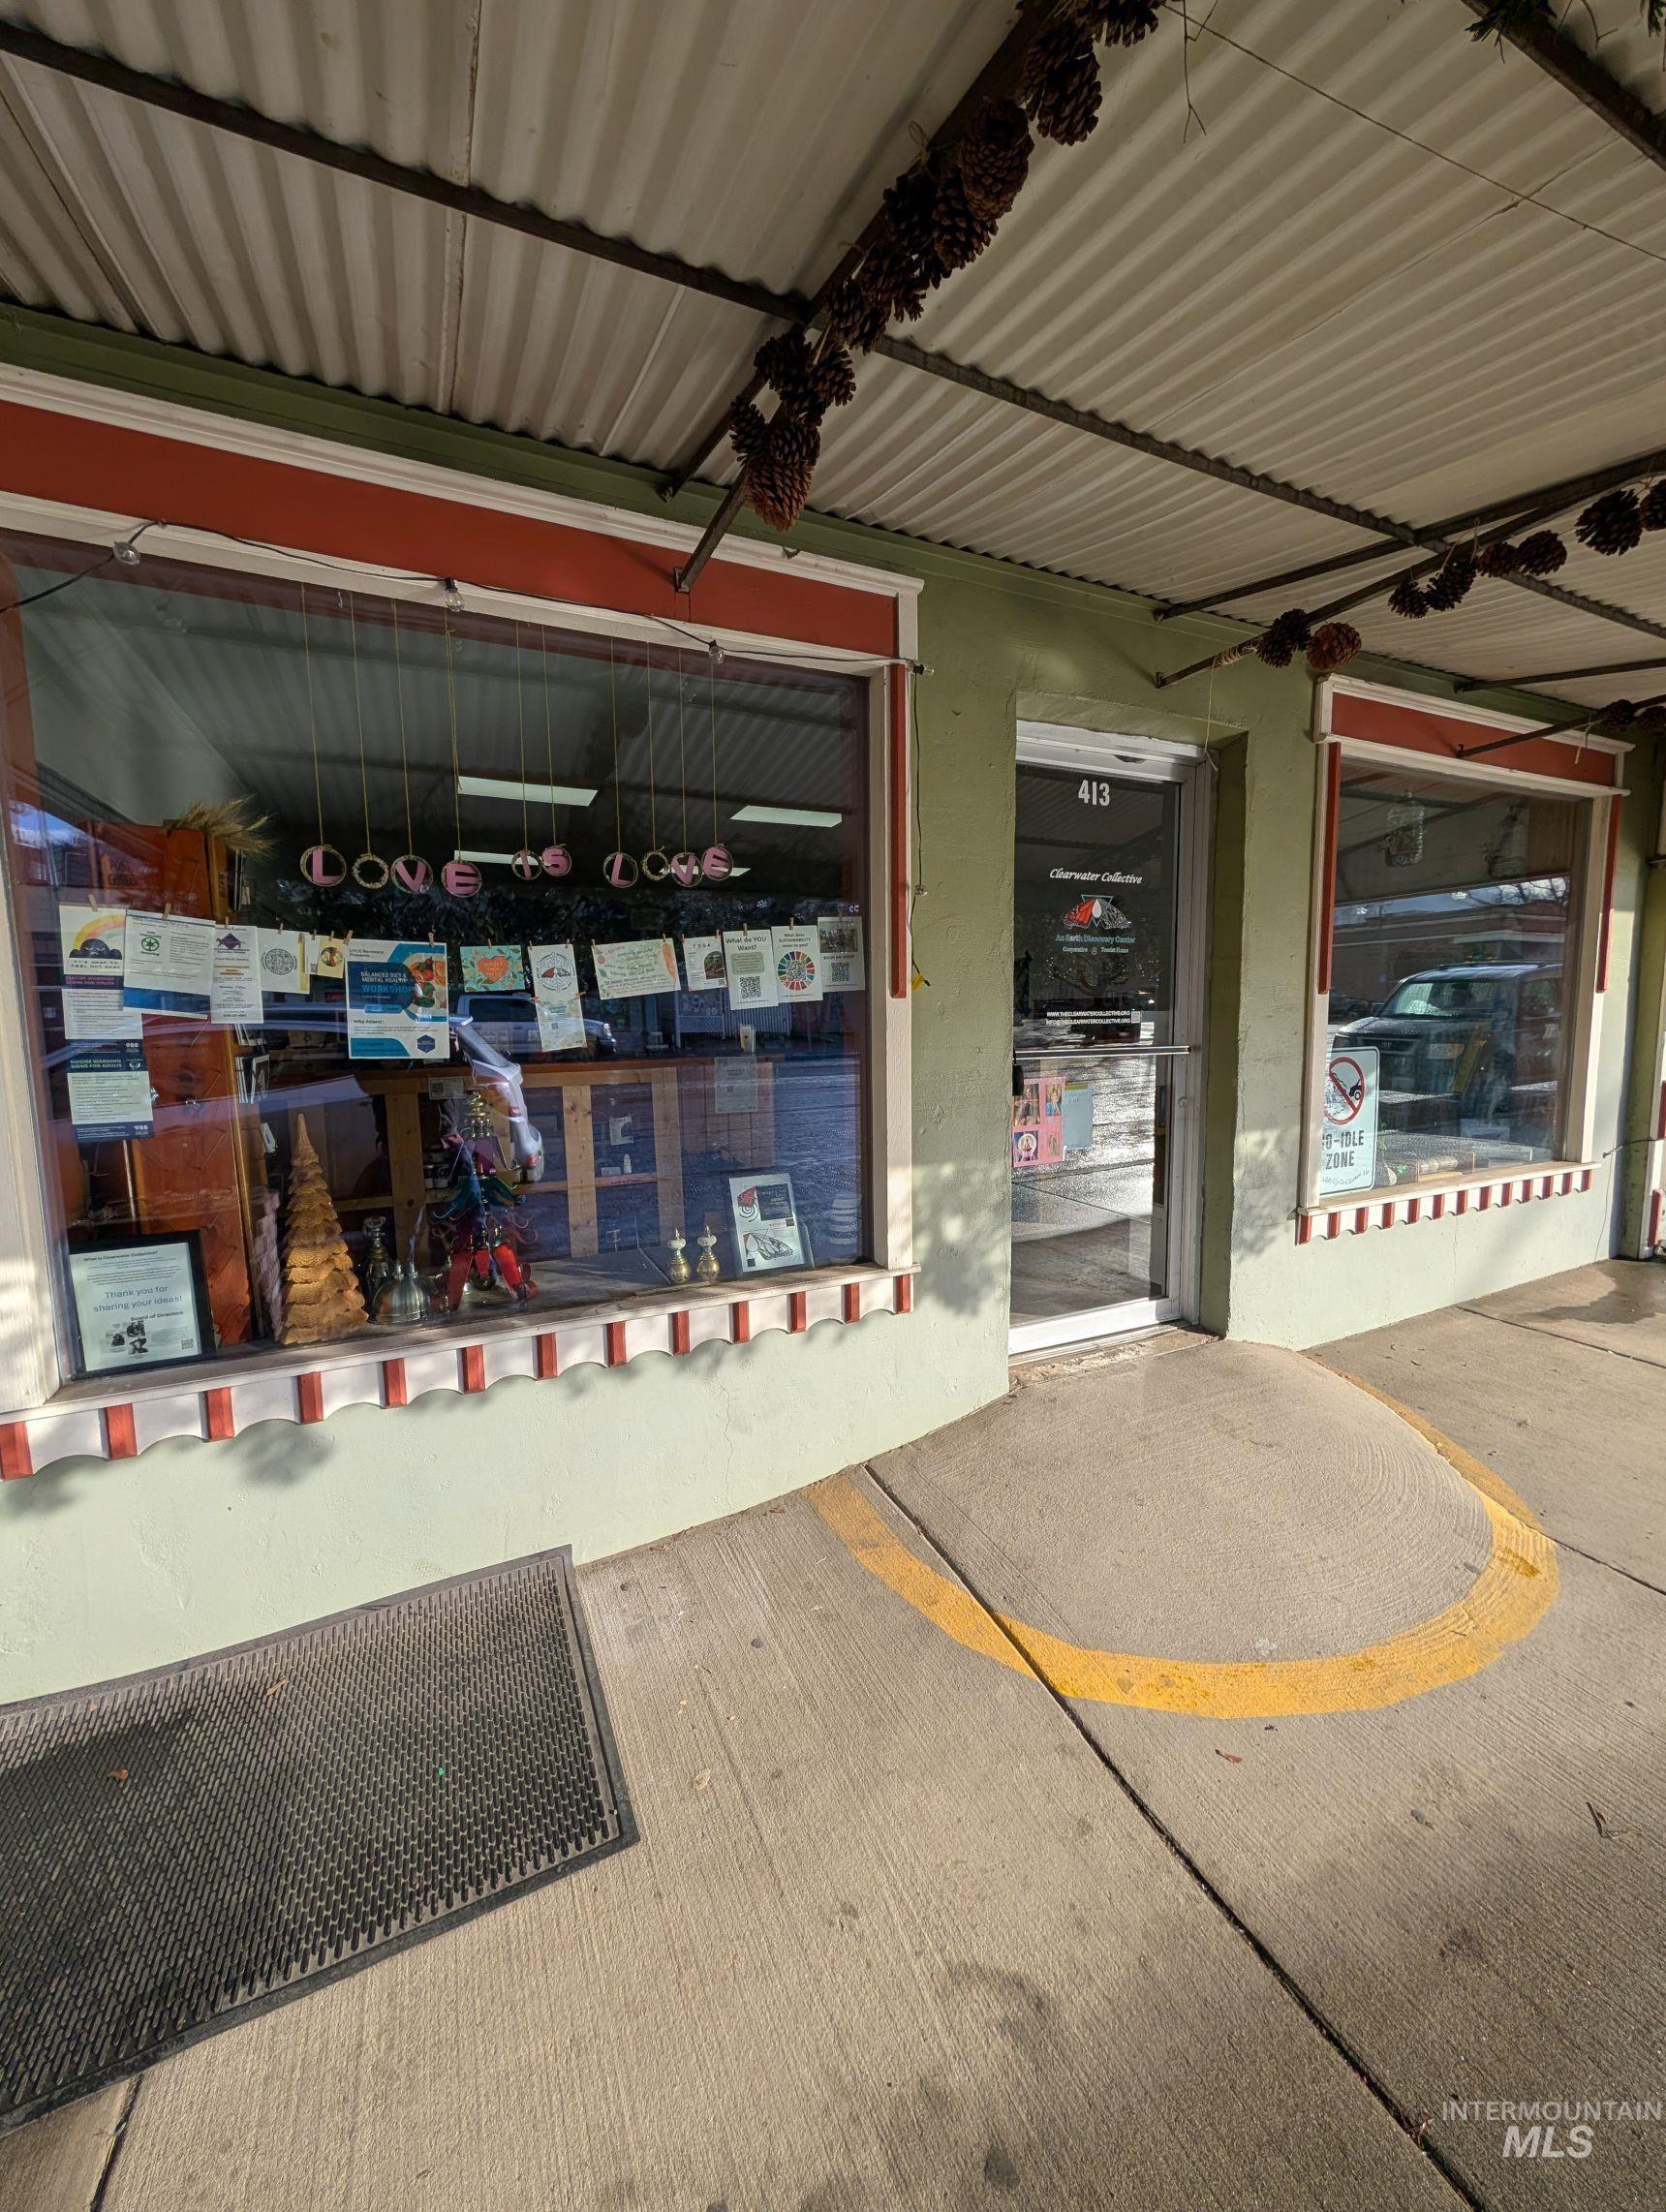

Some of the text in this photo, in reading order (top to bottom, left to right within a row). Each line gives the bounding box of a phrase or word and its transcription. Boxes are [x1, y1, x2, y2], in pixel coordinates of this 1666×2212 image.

[1078, 780, 1110, 806] 413
[1049, 868, 1142, 884] Clearwater Collective
[1055, 934, 1136, 944] An Earth Discovery Center
[1326, 1151, 1355, 1170] ZONE
[105, 1284, 169, 1299] Thank you for
[93, 1295, 182, 1313] sharing your ideas!
